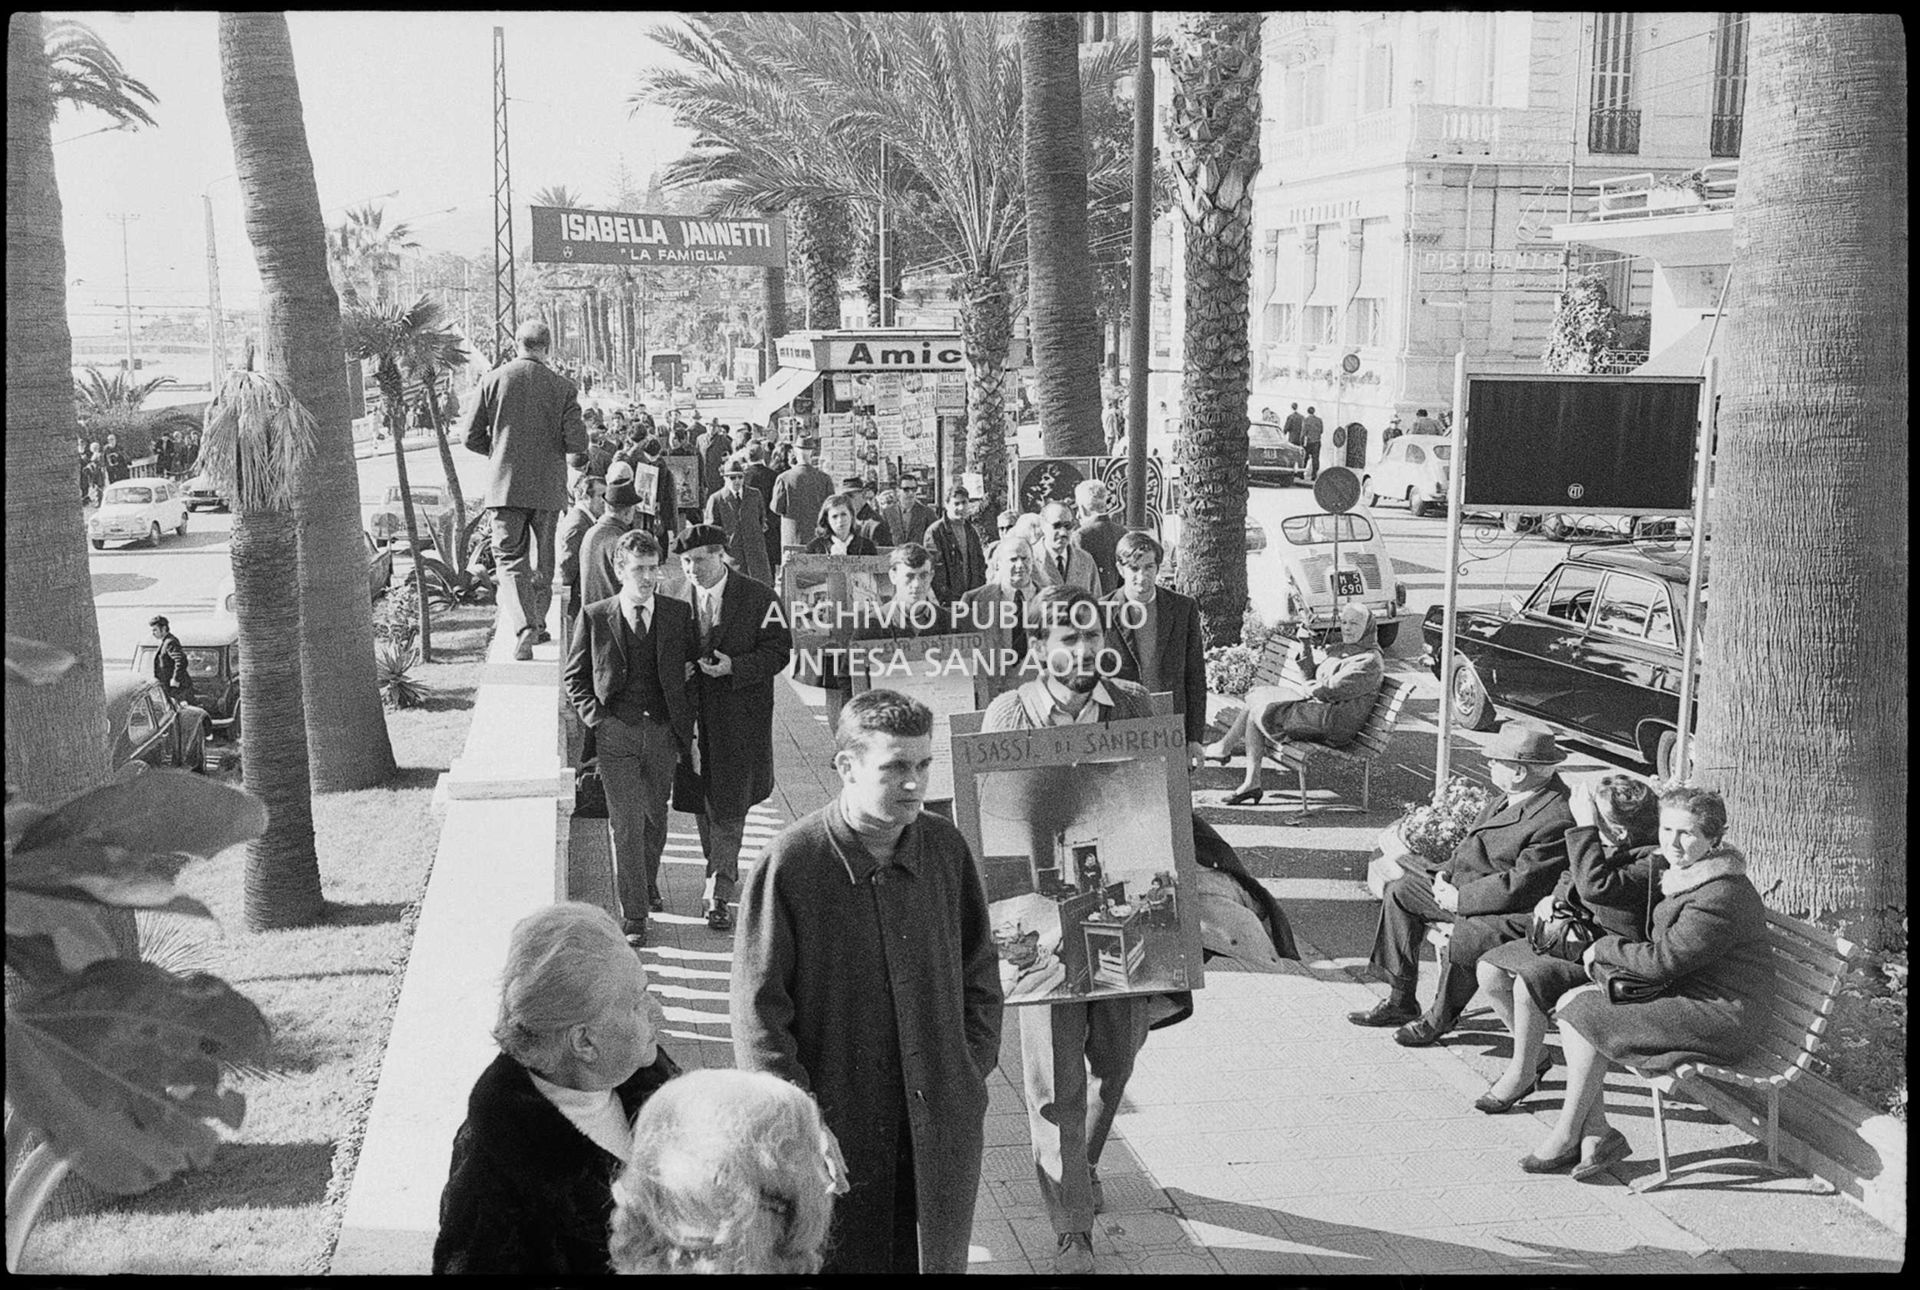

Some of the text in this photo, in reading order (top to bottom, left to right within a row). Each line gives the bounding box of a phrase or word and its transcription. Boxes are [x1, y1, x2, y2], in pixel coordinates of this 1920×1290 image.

[560, 213, 669, 245] ISABELLA
[847, 342, 963, 365] Amic
[1083, 729, 1183, 754] SANREMO
